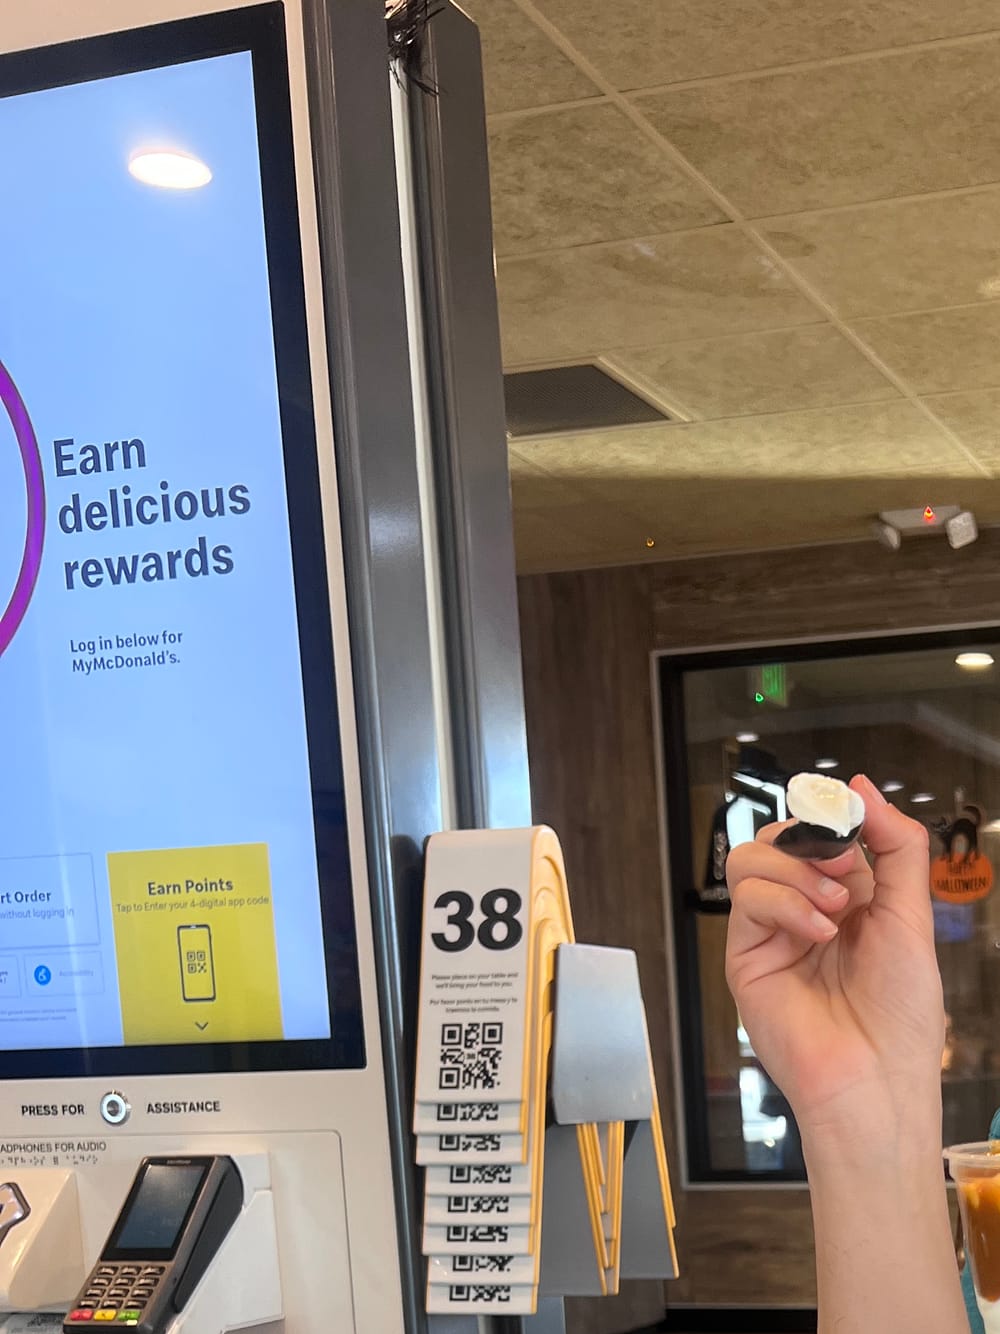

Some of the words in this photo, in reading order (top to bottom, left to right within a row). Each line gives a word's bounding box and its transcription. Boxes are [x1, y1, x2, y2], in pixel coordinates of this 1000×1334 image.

[53, 437, 146, 477] Earn
[58, 480, 251, 534] delicious
[64, 536, 234, 590] rewards
[70, 639, 96, 655] Log
[98, 636, 112, 650] in
[116, 633, 159, 648] below
[162, 630, 183, 644] for
[72, 650, 181, 675] MyMcDonald's.
[14, 889, 52, 903] Order
[148, 881, 181, 896] Earn
[185, 877, 234, 893] Points
[117, 903, 132, 913] Tap
[133, 902, 143, 911] to
[144, 901, 168, 911] Enter
[168, 900, 188, 912] your
[189, 897, 227, 910] 4-digital
[228, 898, 245, 908] app
[246, 896, 269, 905] code
[430, 887, 524, 953] 38
[21, 1104, 59, 1116] PRESS
[61, 1103, 85, 1115] FOR
[146, 1101, 221, 1114] ASSISTANCE
[54, 1141, 75, 1152] FOR
[76, 1140, 107, 1152] AUDIO
